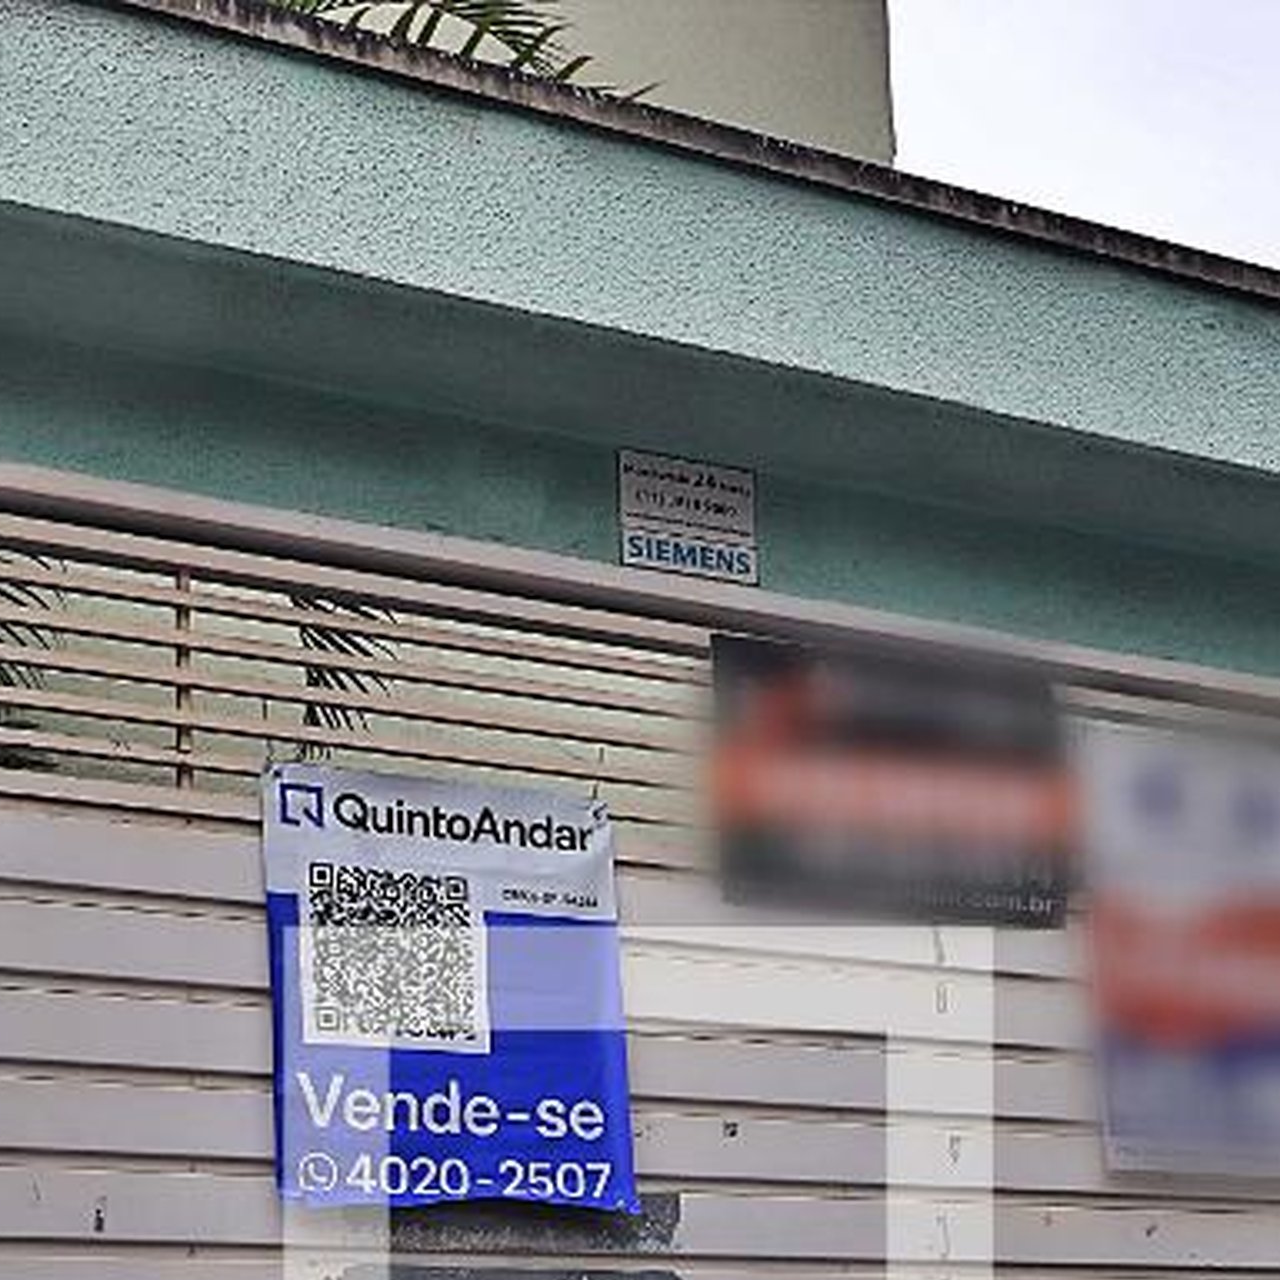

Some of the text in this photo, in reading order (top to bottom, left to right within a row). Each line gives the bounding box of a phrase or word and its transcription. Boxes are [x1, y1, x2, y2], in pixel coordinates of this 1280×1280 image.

[627, 535, 752, 575] SIEMENS
[332, 792, 593, 852] QuintoAndar
[296, 1071, 606, 1141] Vende-se
[345, 1152, 612, 1199] 4020-2507
